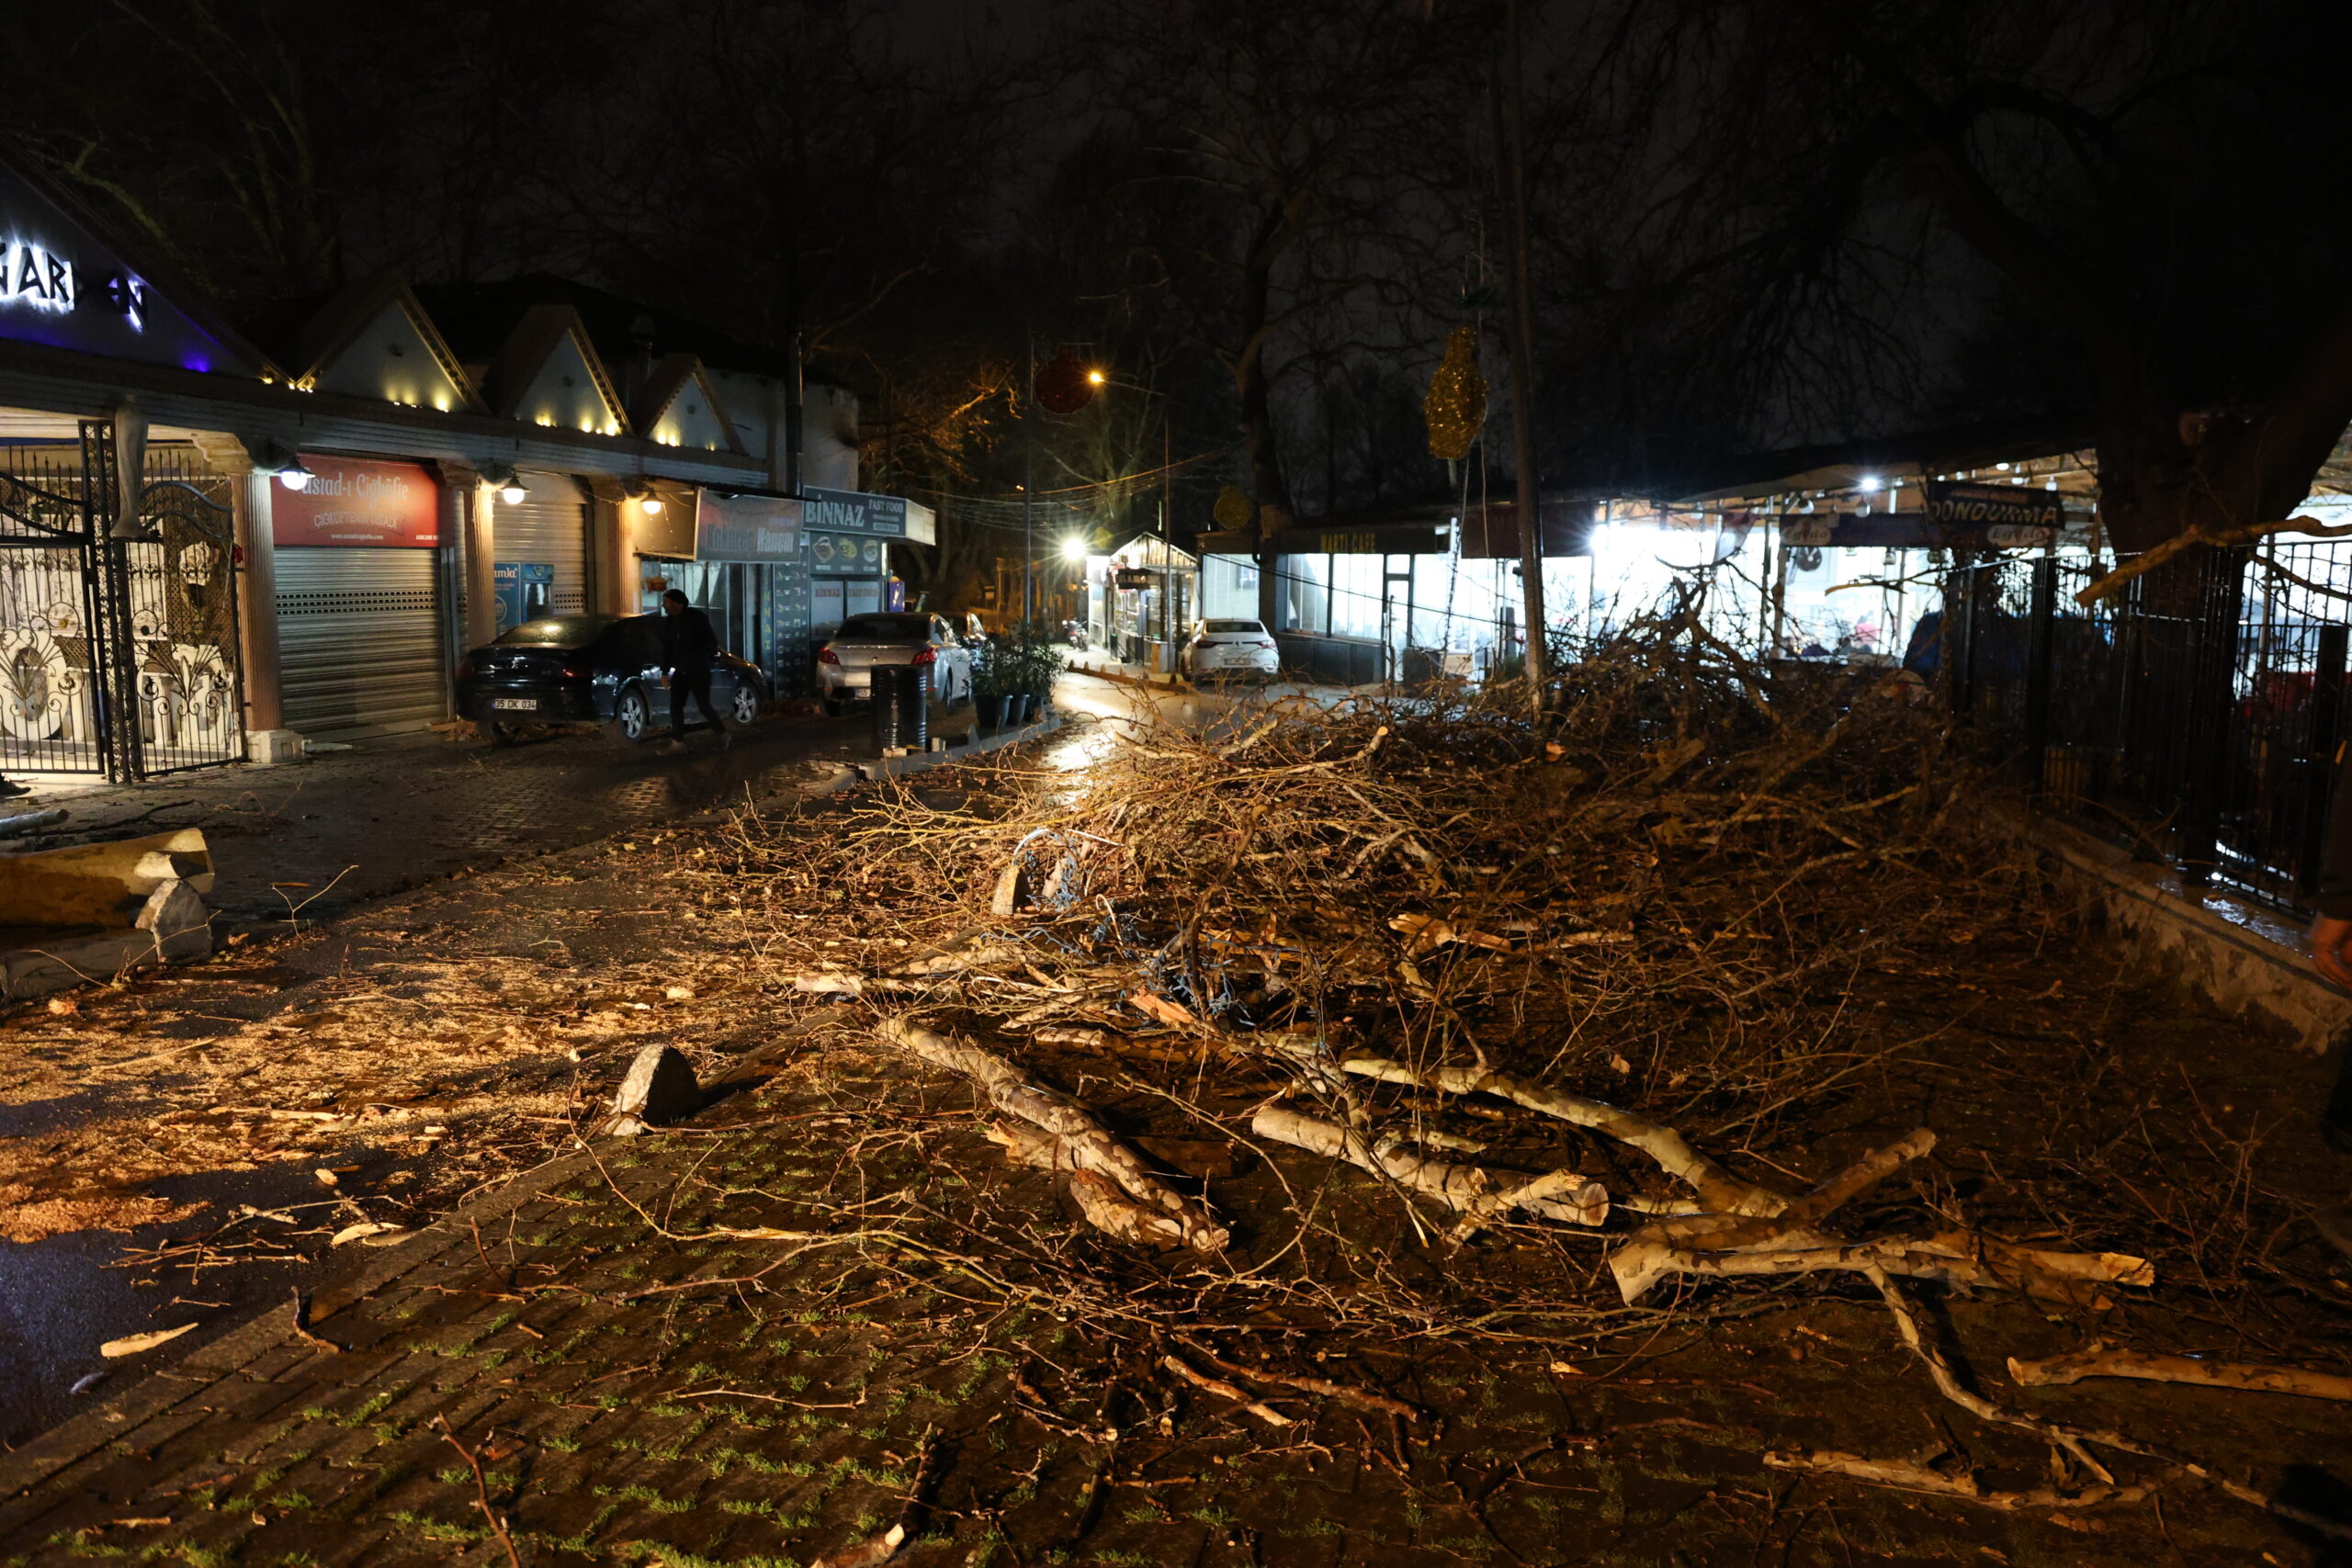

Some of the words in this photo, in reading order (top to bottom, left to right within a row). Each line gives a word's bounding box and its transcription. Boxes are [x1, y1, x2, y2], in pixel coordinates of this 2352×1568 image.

[0, 243, 147, 333] ARDEN
[868, 499, 885, 511] FAST
[886, 501, 904, 513] FOOD
